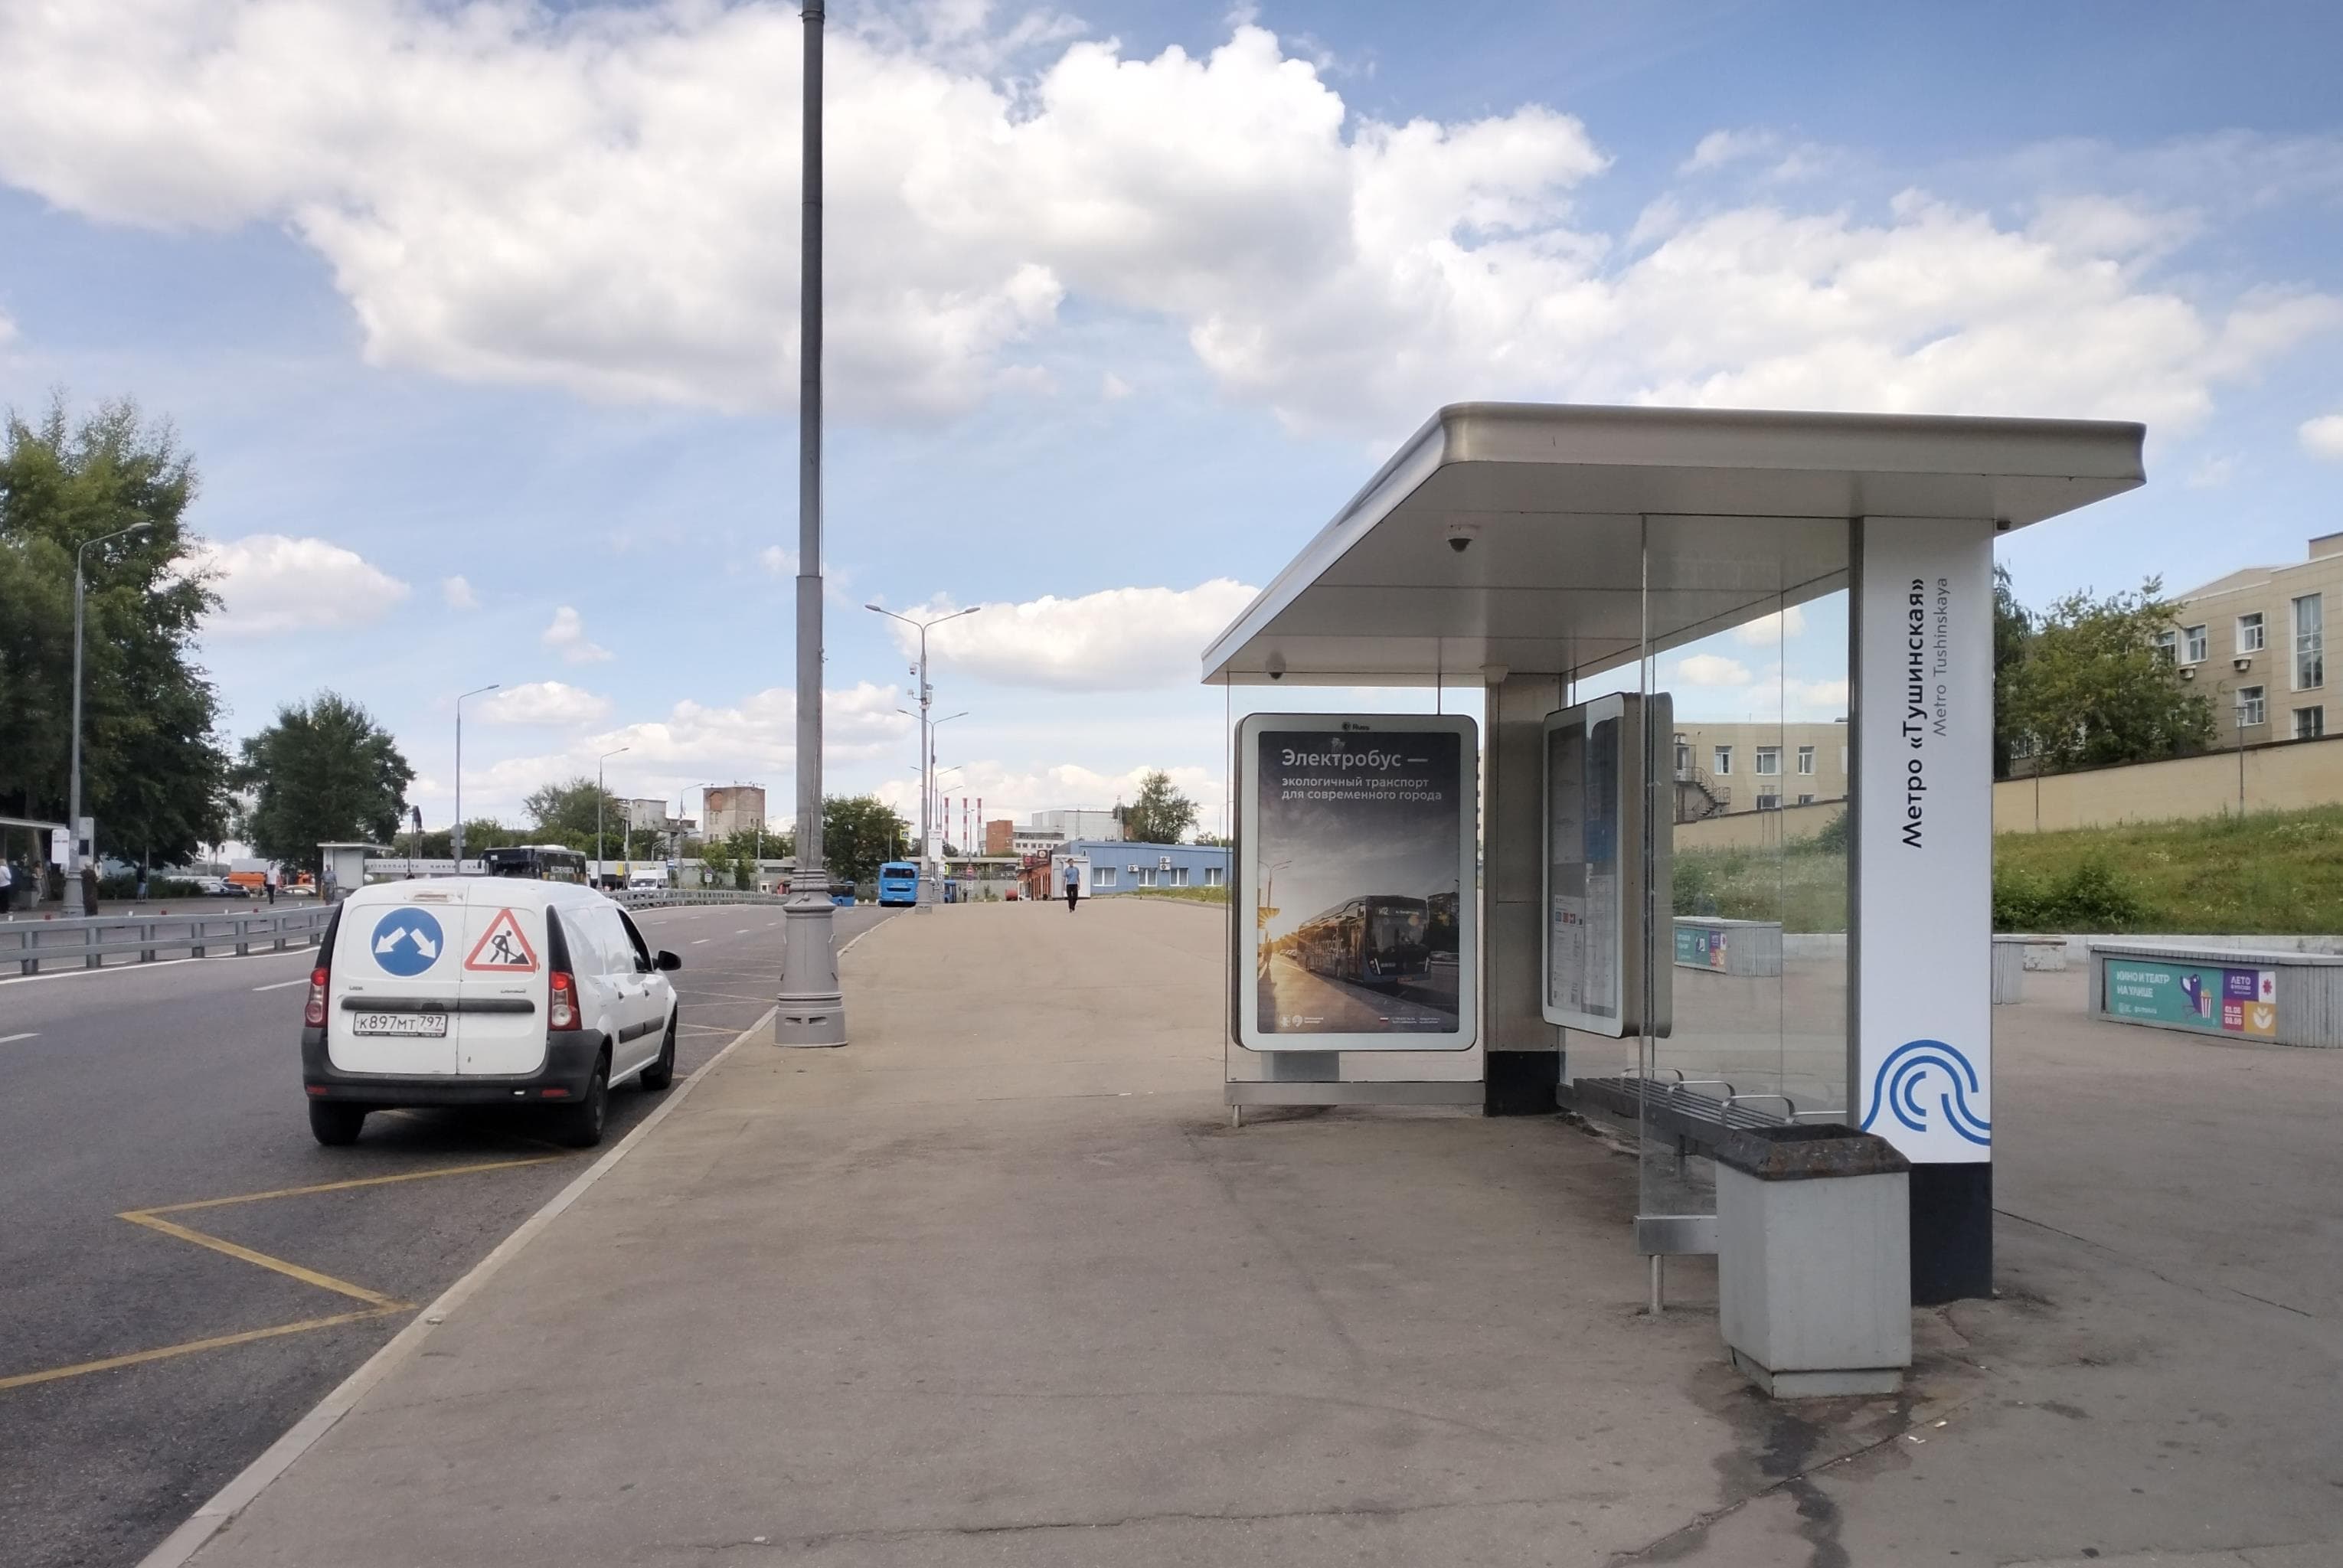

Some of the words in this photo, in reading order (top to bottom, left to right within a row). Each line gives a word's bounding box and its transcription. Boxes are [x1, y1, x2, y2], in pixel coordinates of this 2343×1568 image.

[1933, 579, 1951, 677] Tushinskaya
[1903, 579, 1927, 749] «Тушинская»
[1933, 684, 1947, 737] Metro
[1282, 749, 1401, 770] Электробус
[1282, 776, 1363, 787] экологичный
[1365, 778, 1429, 789] транспорт
[1282, 790, 1304, 801] для
[1307, 791, 1396, 802] современного
[1400, 792, 1443, 802] города
[1903, 759, 1926, 848] Метро
[2145, 972, 2170, 985] ТЕАТР
[2230, 976, 2251, 985] ЛЕТО
[2117, 985, 2128, 995] НА
[2129, 985, 2154, 998] УЛИЦЕ
[420, 1015, 443, 1027] 797
